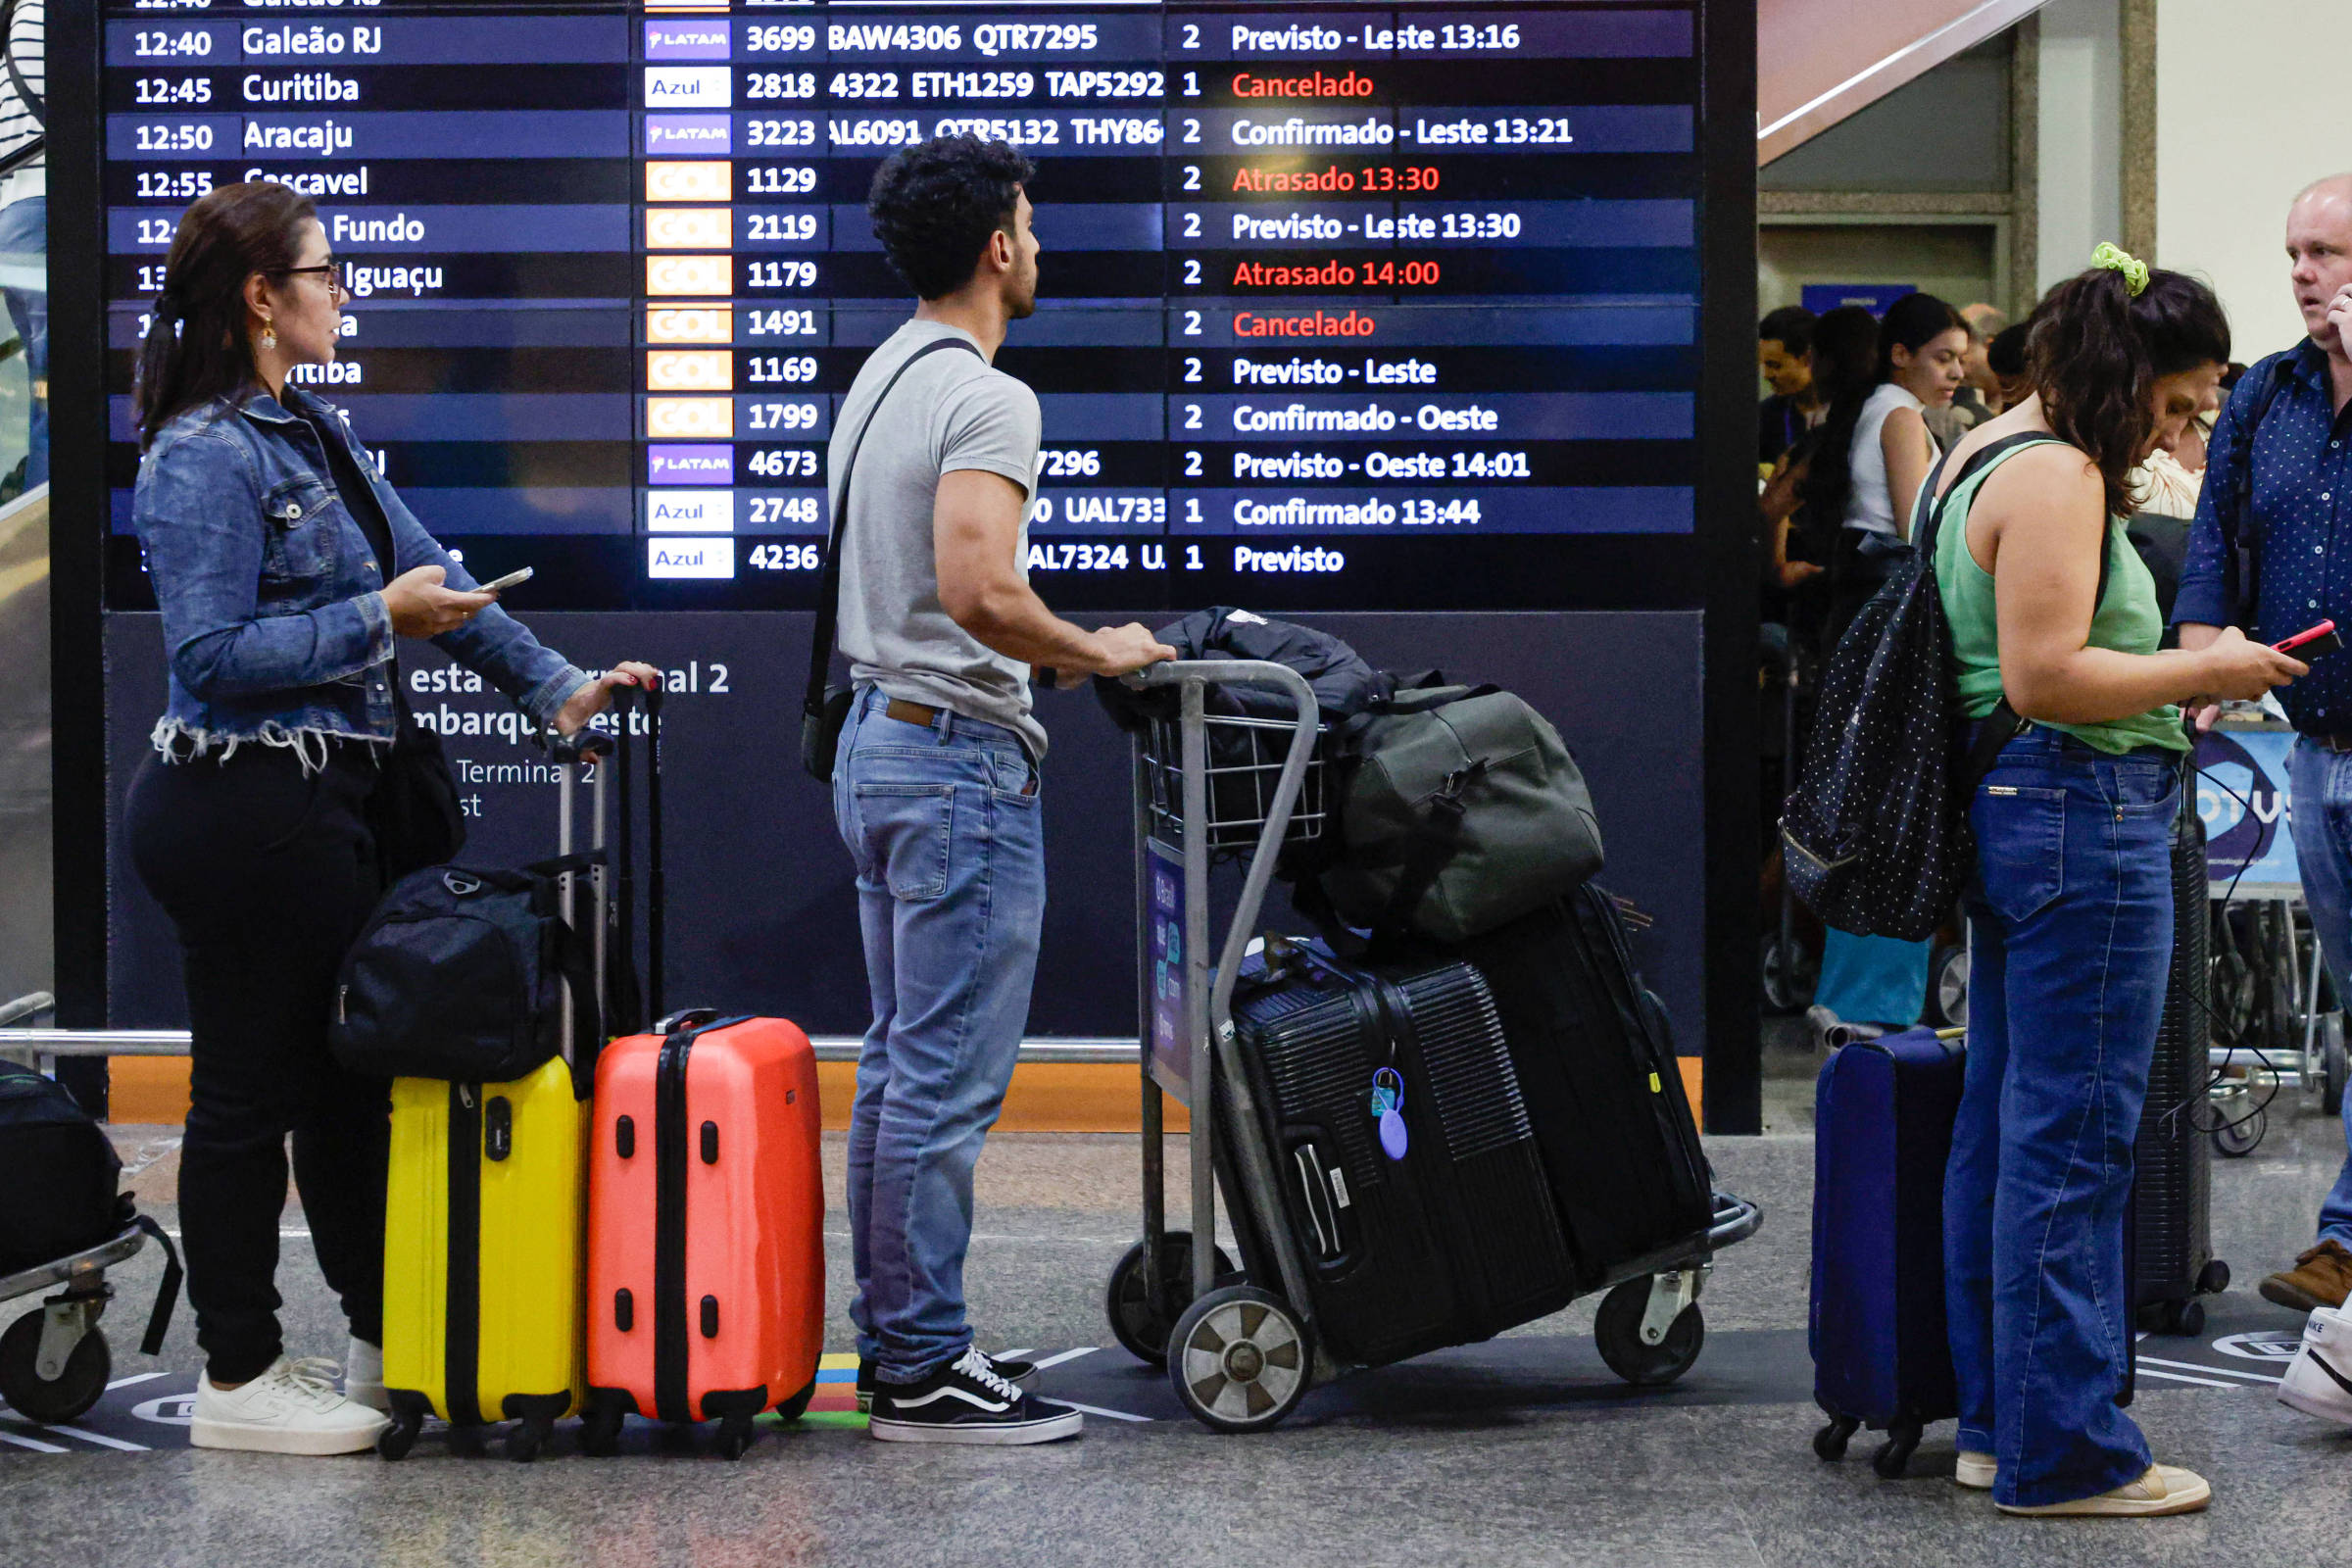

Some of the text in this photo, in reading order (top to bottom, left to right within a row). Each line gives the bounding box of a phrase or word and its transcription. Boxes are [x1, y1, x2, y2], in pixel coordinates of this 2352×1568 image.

[136, 31, 212, 55] 12:40
[243, 25, 345, 54] Galeão
[354, 27, 380, 53] RJ
[663, 32, 727, 45] LATAM
[748, 26, 815, 51] 3699
[829, 25, 961, 50] BAW4306
[974, 24, 1097, 56] QTR7295
[1183, 24, 1200, 48] 2
[1233, 24, 1341, 50] Previsto
[1365, 25, 1435, 49] Leste
[1442, 24, 1520, 48] 13:16
[136, 71, 1373, 102] 12:45 Curitiba Azul 2818 4322 ETH1259 TAP5292 1 Cancelado
[137, 125, 213, 150] 12:50
[245, 121, 352, 155] Aracaju
[663, 126, 727, 139] LATAM
[748, 121, 815, 145] 3223
[1070, 119, 1163, 144] THY86
[1184, 119, 1200, 142] 2
[1232, 118, 1394, 144] Confirmado
[1418, 120, 1488, 143] Leste
[1494, 119, 1572, 143] 13:21
[138, 172, 213, 196] 12:55
[650, 167, 727, 198] GOL
[749, 168, 815, 192] 1129
[1184, 167, 1200, 189] 2
[1233, 166, 1354, 191] Atrasado
[1362, 167, 1439, 190] 13:30
[334, 213, 424, 241] Fundo
[650, 214, 727, 245] GOL
[748, 215, 816, 239] 2119
[1184, 214, 1200, 236] 2
[1234, 213, 1342, 239] Previsto
[1366, 214, 1436, 238] Leste
[1443, 214, 1520, 237] 13:30
[346, 260, 1440, 296] Iguaçu GOL 1179 2 Atrasado 14:00
[651, 310, 1375, 339] GOL 1491 2 Cancelado
[651, 355, 729, 385] GOL
[750, 358, 816, 381] 1169
[1185, 358, 1201, 381] 2
[1235, 358, 1343, 383] Previsto
[1367, 360, 1436, 383] Leste
[652, 402, 729, 433] GOL
[750, 404, 817, 428] 1799
[1185, 405, 1201, 428] 2
[1234, 404, 1396, 431] Confirmado
[1418, 405, 1497, 430] Oeste
[666, 458, 730, 470] LATAM
[749, 451, 816, 475] 4673
[1037, 450, 1101, 476] 7296
[1186, 452, 1202, 475] 2
[1235, 452, 1343, 477] Previsto
[1366, 453, 1446, 477] Oeste
[1452, 453, 1530, 476] 14:01
[655, 503, 703, 518] Azul
[750, 498, 818, 522] 2748
[1186, 499, 1202, 522] 1
[1235, 498, 1396, 524] Confirmado
[1402, 500, 1481, 524] 13:44
[655, 550, 704, 565] Azul
[750, 545, 818, 569] 4236
[1027, 544, 1129, 569] AL7324
[1187, 546, 1202, 568] 1
[1236, 546, 1344, 571] Previsto
[410, 662, 482, 693] esta
[709, 663, 729, 693] 2
[413, 703, 662, 745] mbarqu est
[457, 759, 596, 783] Termina 2
[460, 793, 482, 816] st
[2196, 789, 2291, 823] OTV
